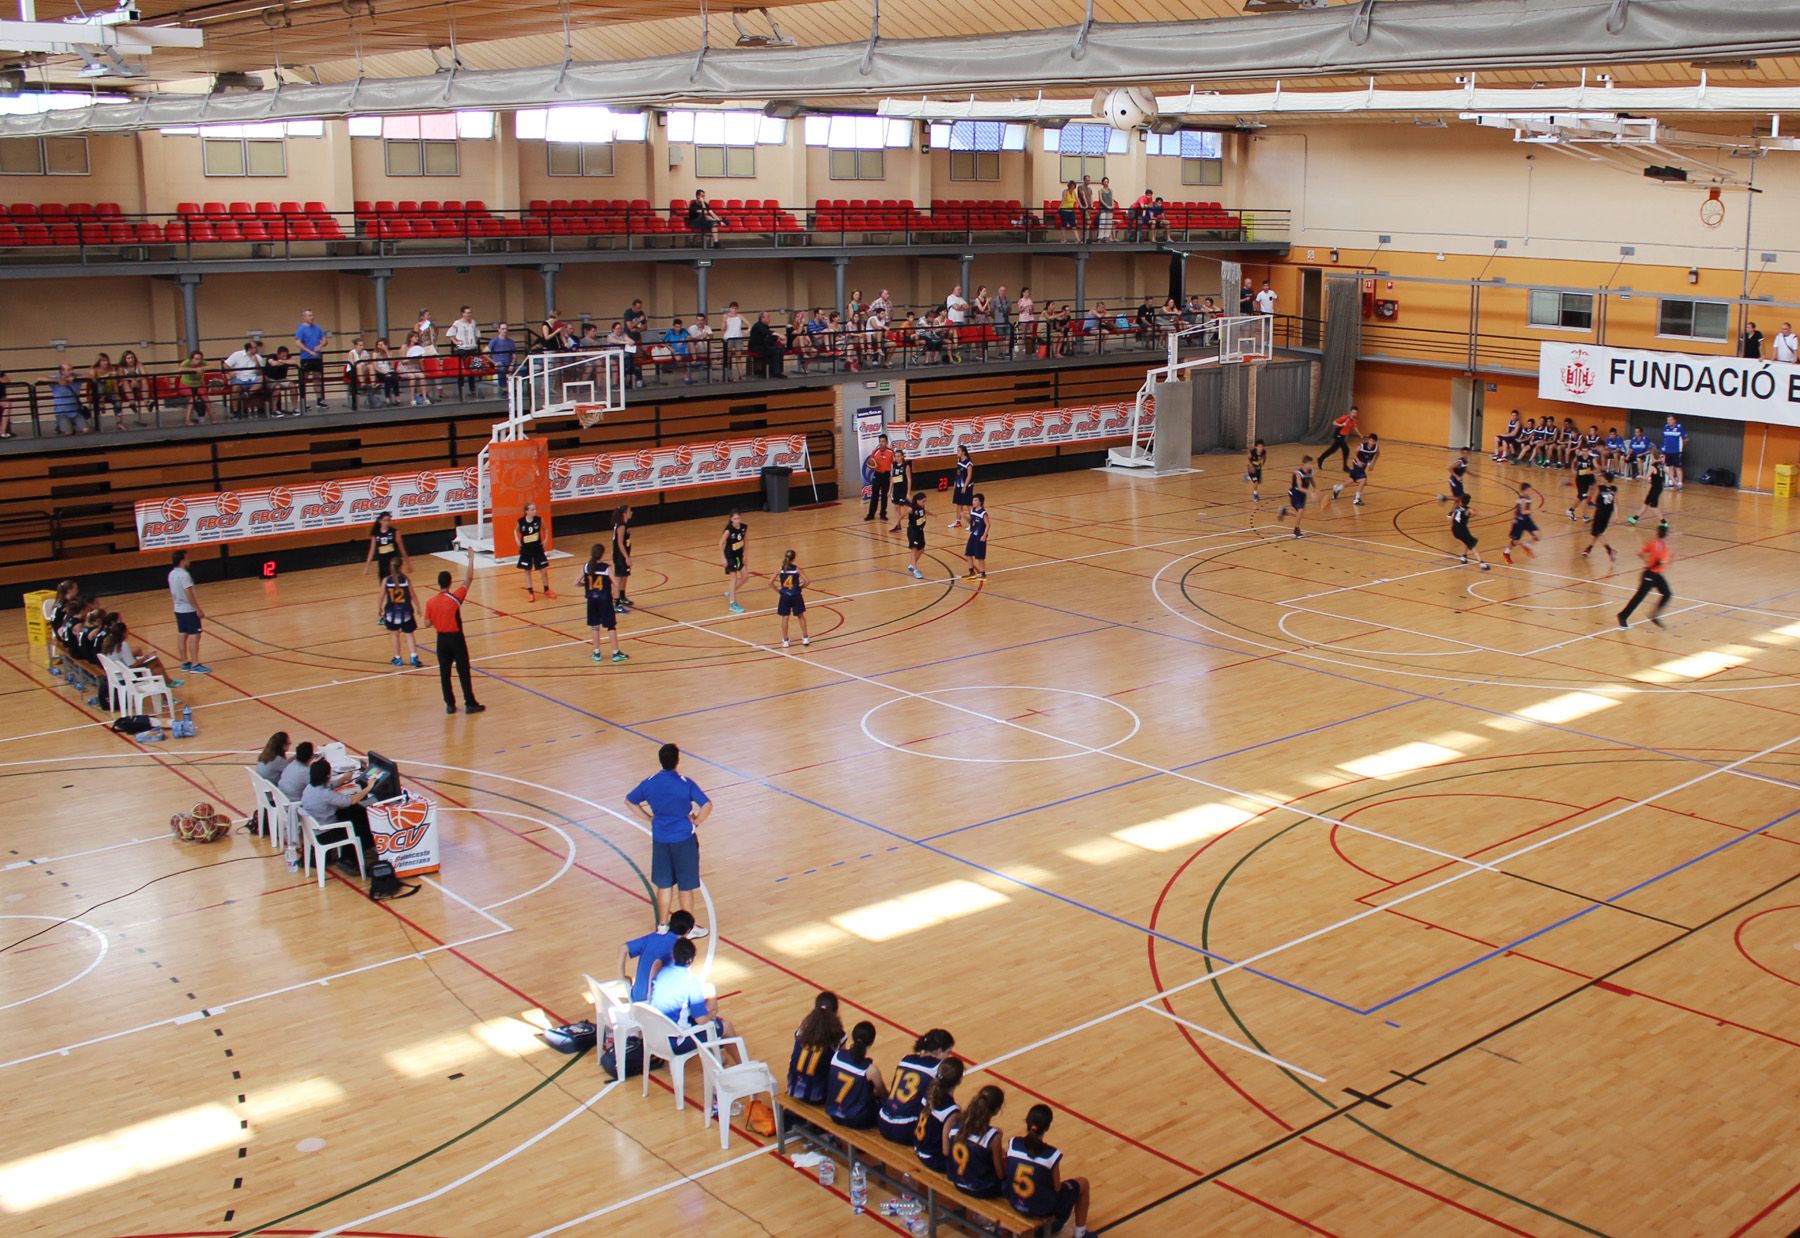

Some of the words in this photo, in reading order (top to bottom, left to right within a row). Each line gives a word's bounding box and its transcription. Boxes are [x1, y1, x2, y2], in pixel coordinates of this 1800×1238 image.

[1610, 358, 1776, 400] FUNDACIÓ
[142, 519, 189, 537] FBCV
[195, 512, 243, 531] FBCV
[248, 507, 294, 525] FBCV
[300, 501, 344, 519] FBCV
[349, 495, 392, 513] FBCV
[397, 490, 440, 508] FBCV
[528, 526, 533, 534] 9
[388, 588, 405, 603] 12
[588, 575, 603, 591] 14
[783, 575, 794, 590] 4
[372, 823, 431, 855] BCV
[796, 1045, 823, 1077] 11
[835, 1071, 856, 1104] 7
[888, 1069, 921, 1104] 13
[951, 1142, 970, 1176] 9
[1011, 1162, 1036, 1200] 5
